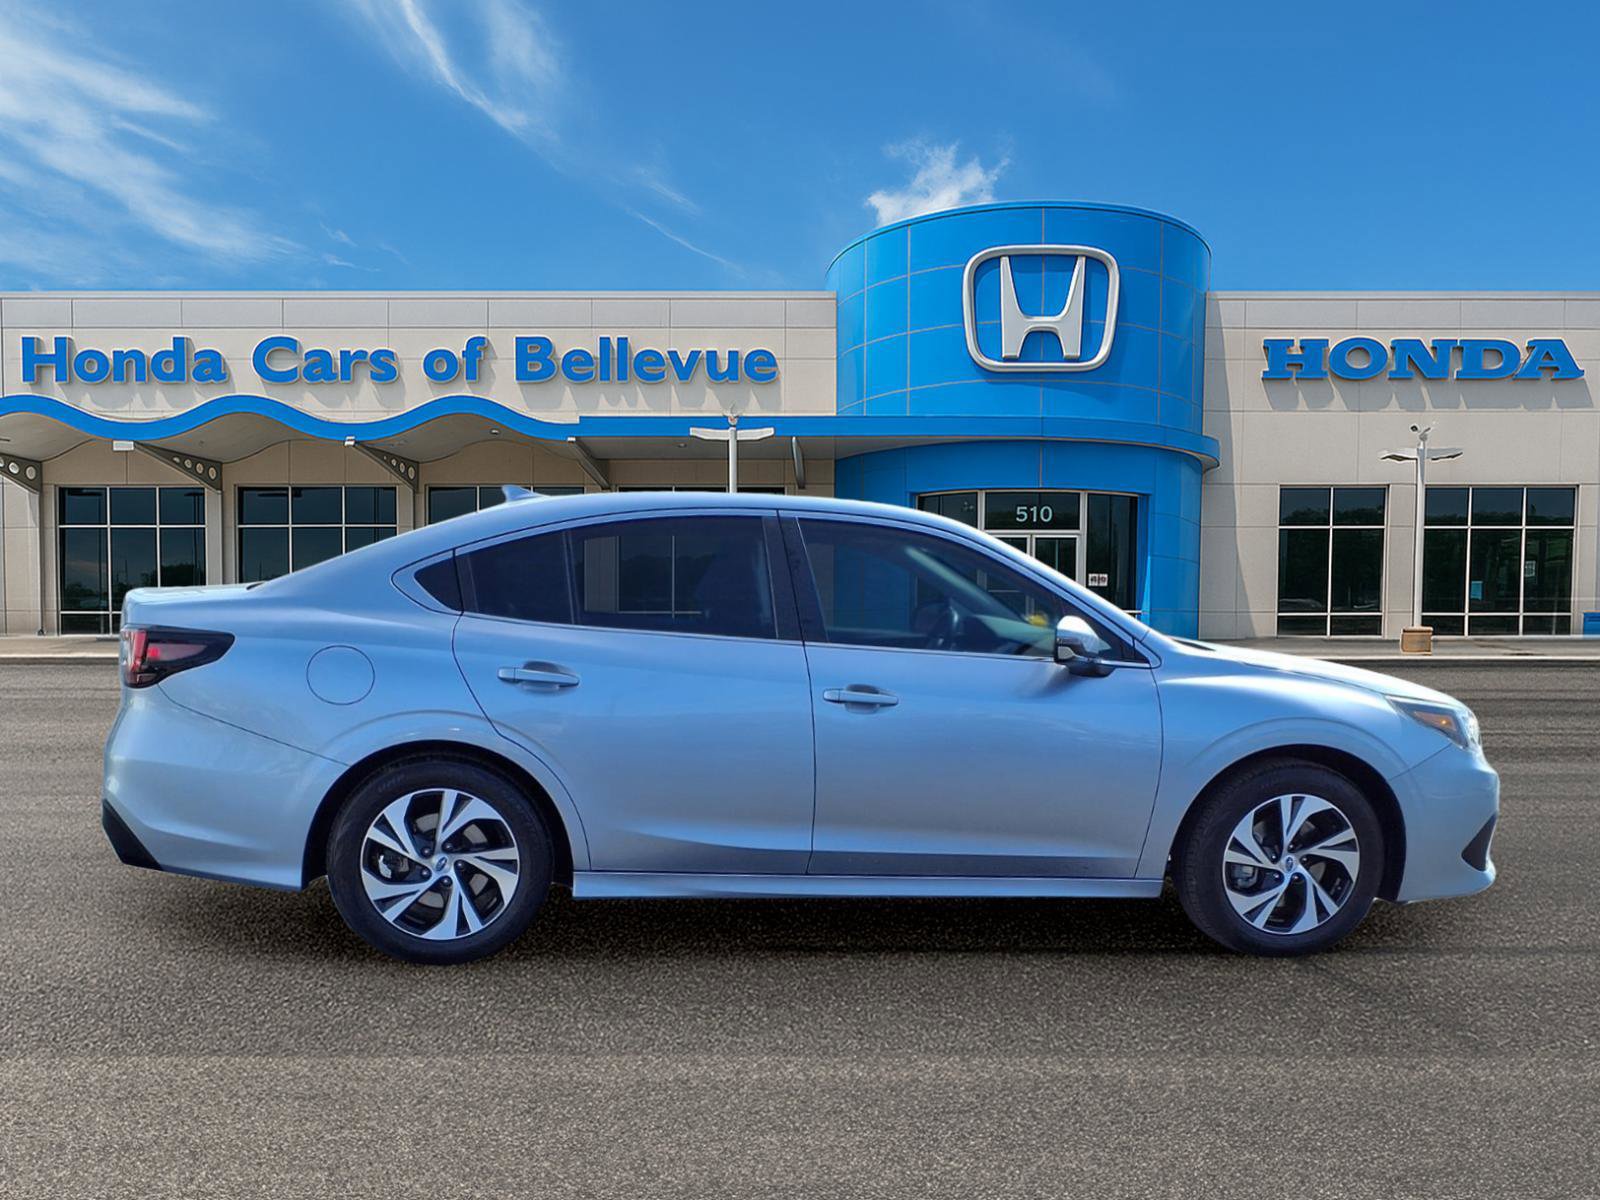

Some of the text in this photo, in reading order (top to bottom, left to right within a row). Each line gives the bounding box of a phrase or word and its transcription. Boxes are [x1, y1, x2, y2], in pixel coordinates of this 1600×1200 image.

[21, 335, 780, 384] Honda Cars of Bellevue
[1262, 336, 1585, 382] HONDA
[1015, 506, 1053, 523] 510
